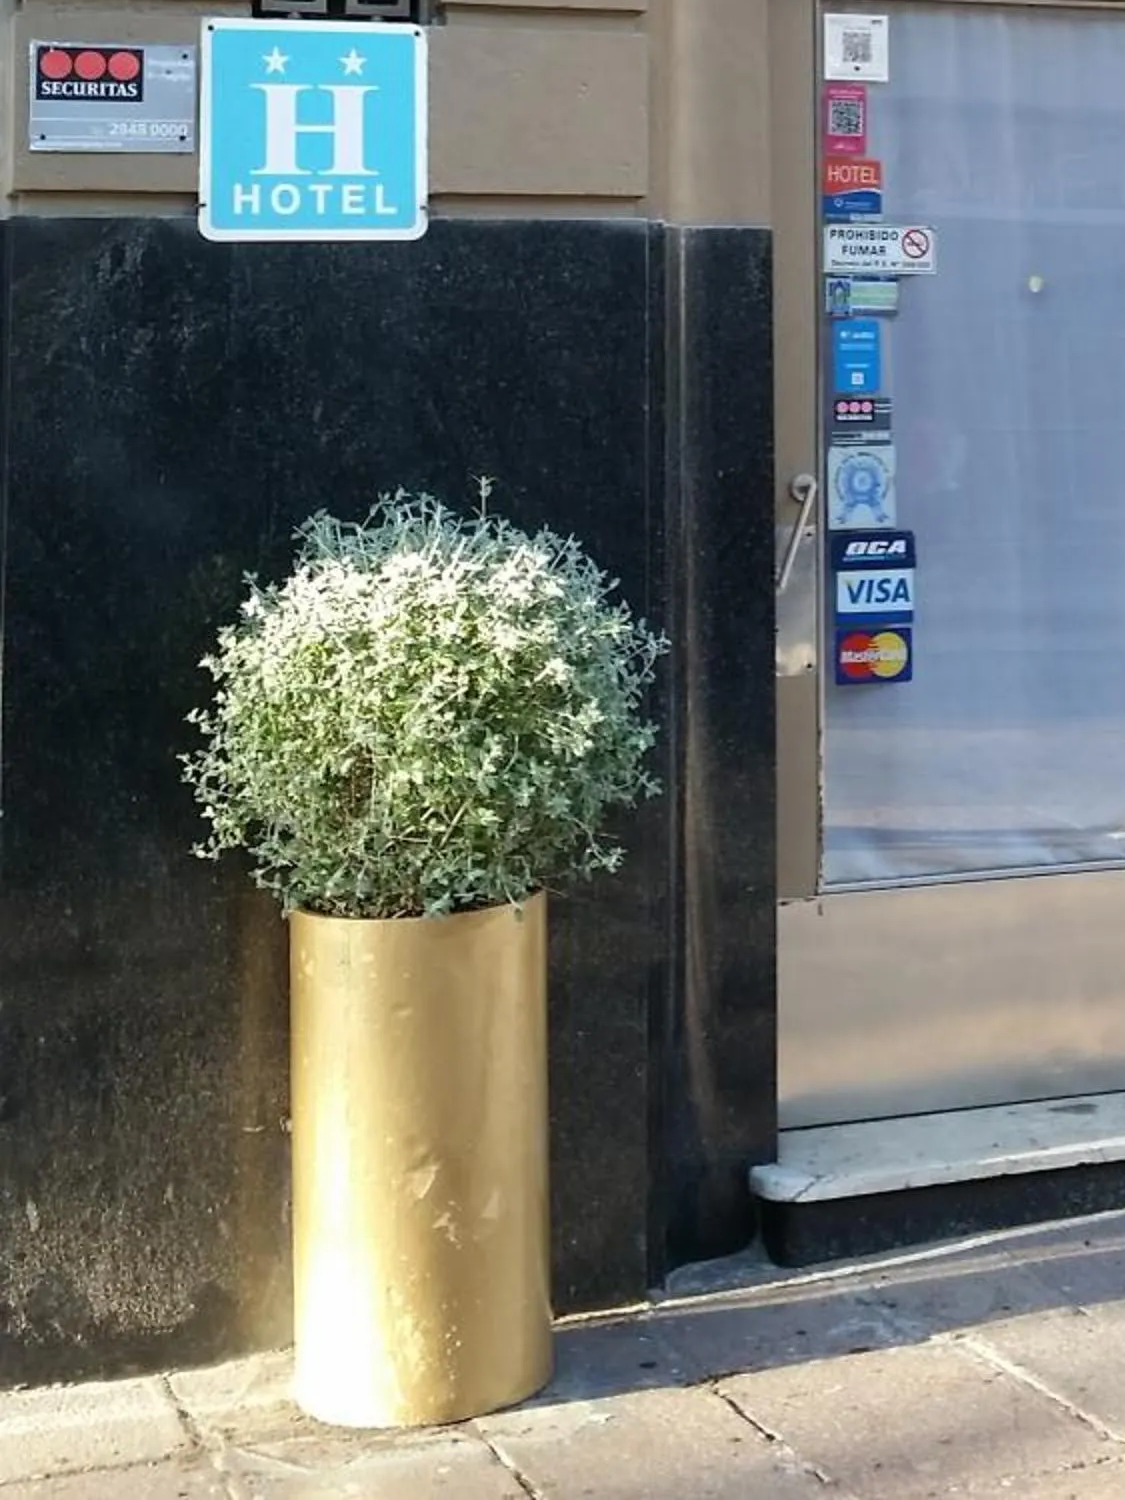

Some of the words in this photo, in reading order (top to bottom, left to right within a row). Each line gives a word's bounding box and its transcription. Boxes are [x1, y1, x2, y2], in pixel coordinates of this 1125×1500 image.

[41, 81, 138, 96] SECURITAS
[249, 83, 379, 175] H
[827, 164, 879, 184] HOTEL
[233, 183, 397, 215] HOTEL
[829, 229, 899, 241] PROHIBIDO
[842, 245, 886, 255] FUMAR
[845, 577, 910, 604] VISA
